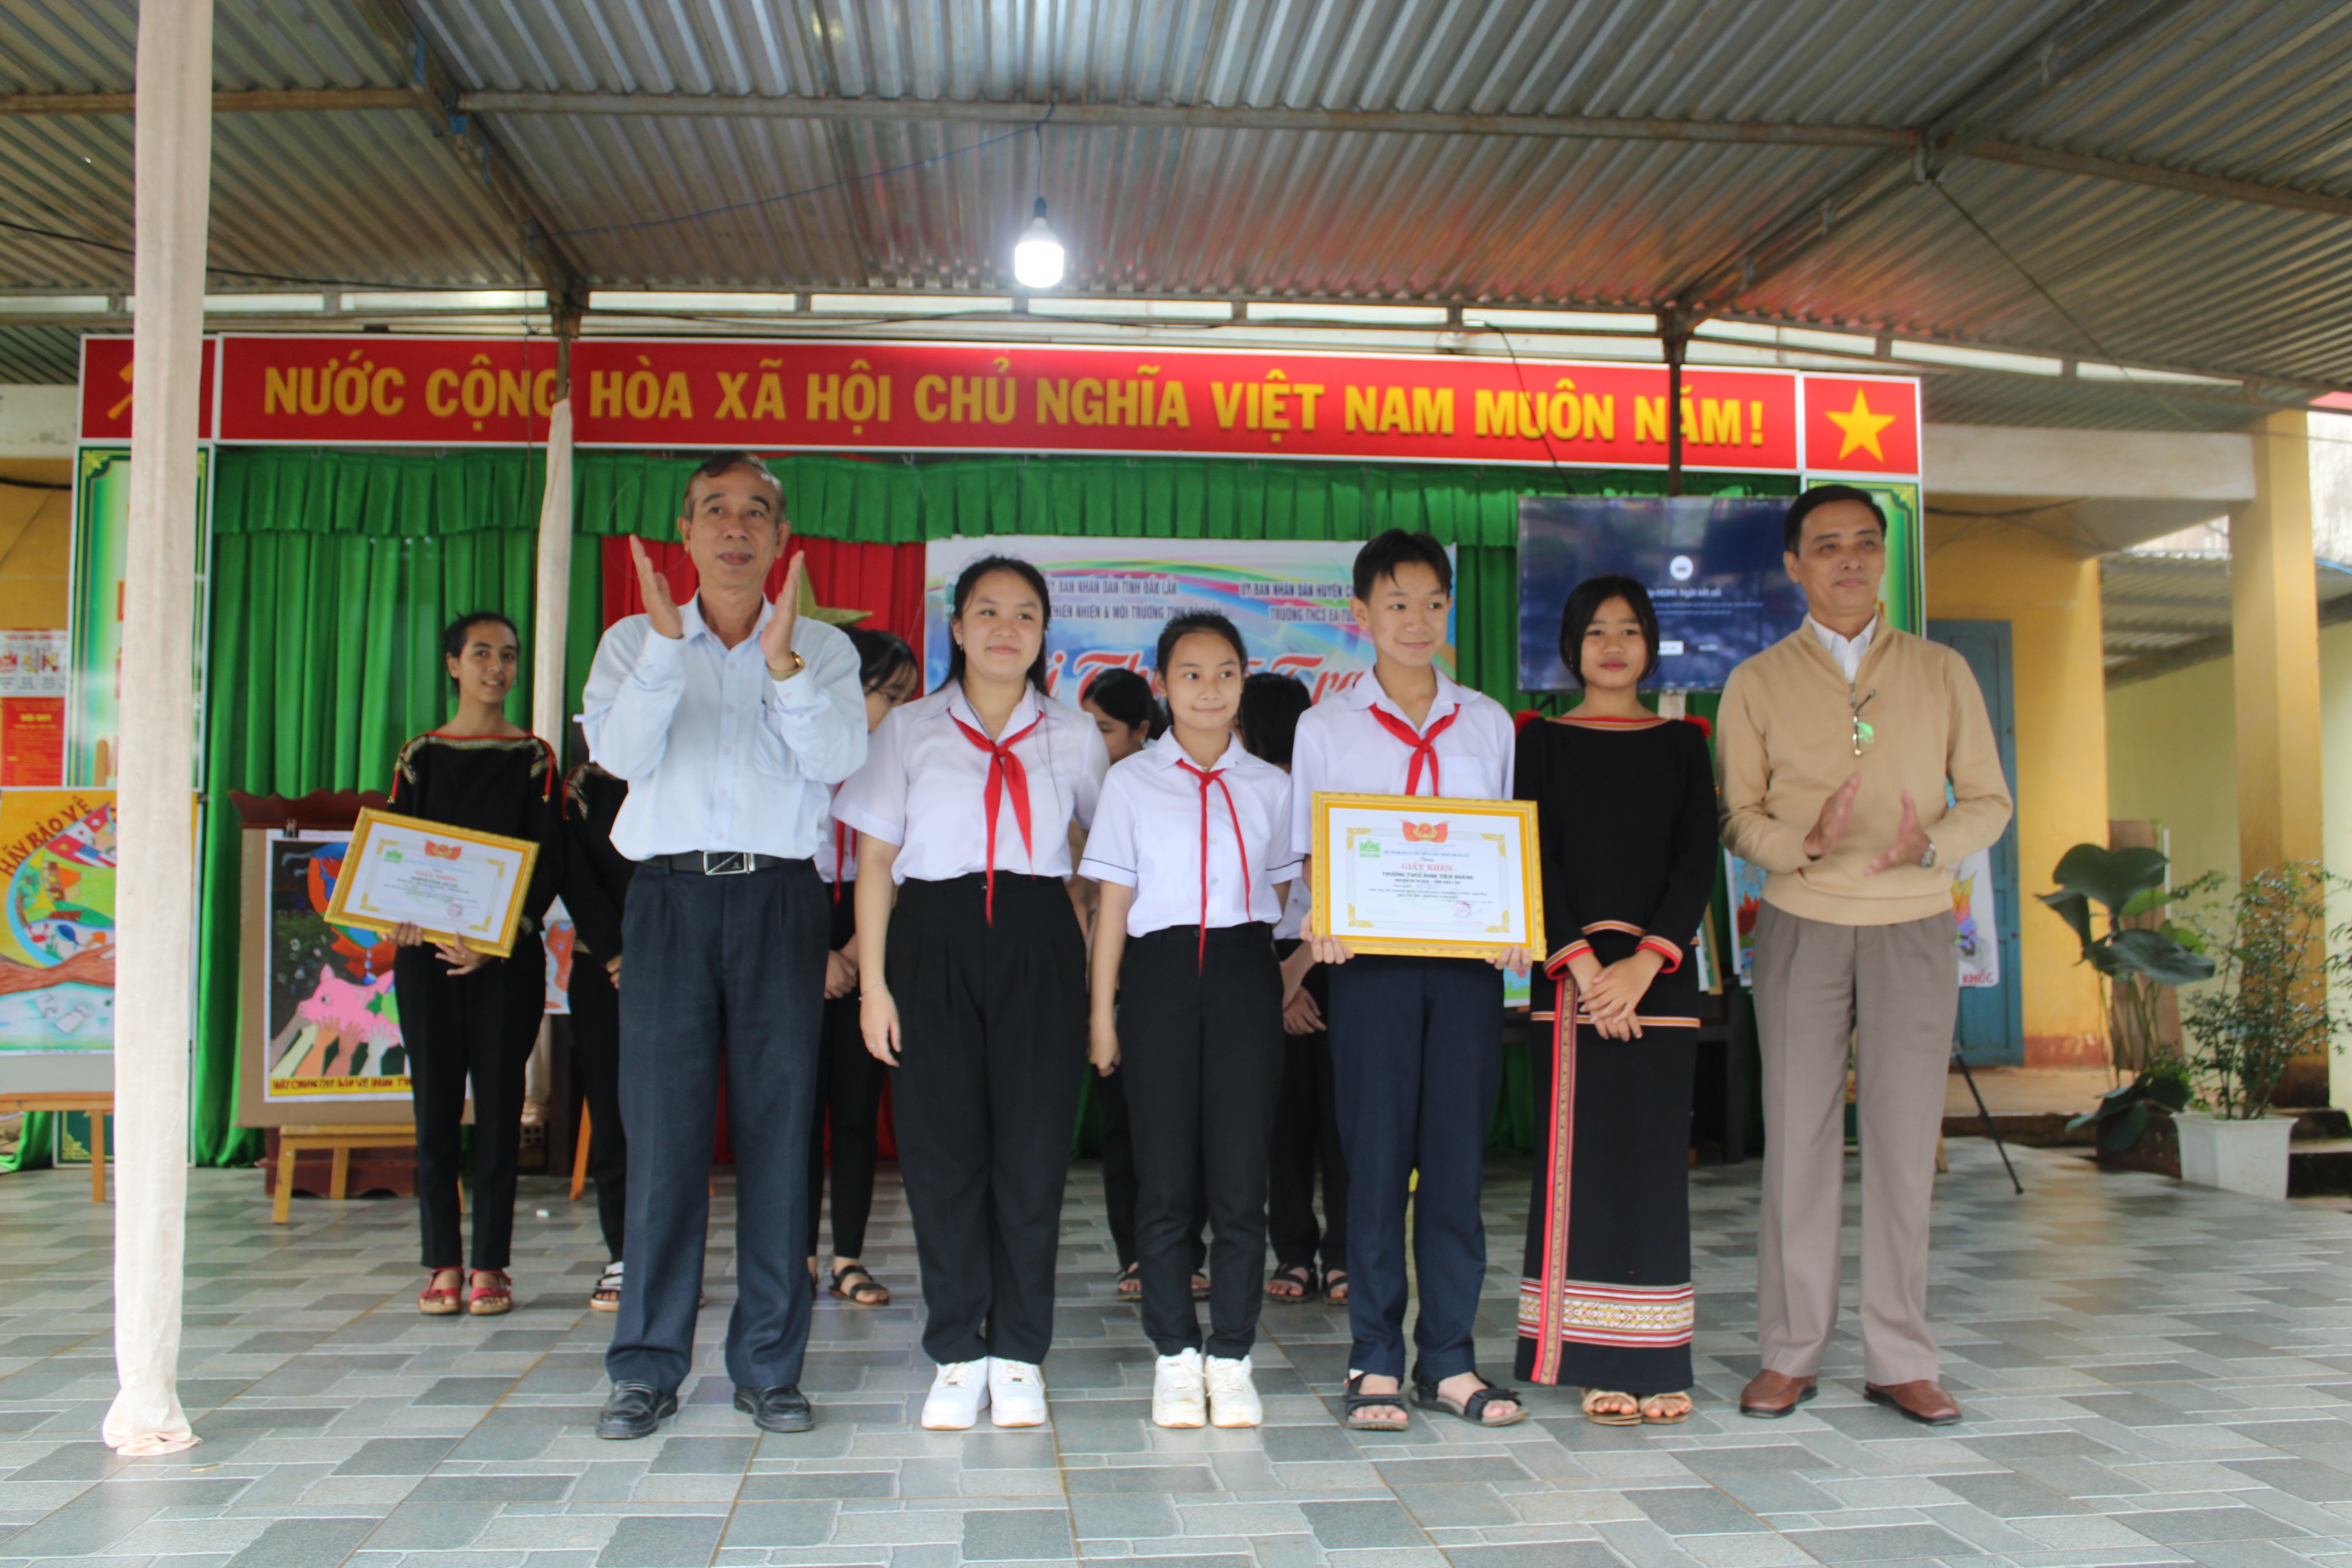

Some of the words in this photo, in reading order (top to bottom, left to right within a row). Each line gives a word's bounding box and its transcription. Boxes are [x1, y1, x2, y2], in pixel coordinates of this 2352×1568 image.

[263, 349, 405, 416] NƯỚC
[425, 353, 557, 431] CỘNG
[588, 355, 693, 419] HÒA
[713, 358, 786, 420] XÃ
[806, 359, 891, 435] HỘI
[913, 356, 1016, 424] CHỦ
[1035, 364, 1191, 428] NGHĨA
[1210, 368, 1325, 444] VIỆT
[1344, 385, 1455, 436] NAM
[1474, 377, 1615, 443] MUÔN
[1059, 580, 1074, 593] BAN
[1077, 576, 1099, 594] NHÂN
[1103, 576, 1119, 594] DÂN
[1254, 584, 1269, 597] BAN
[1273, 580, 1294, 597] NHÂN
[1297, 580, 1313, 597] DÂN
[1075, 601, 1100, 619] NHIÊN
[1270, 603, 1303, 621] TRƯỜNG
[1305, 608, 1326, 621] THCS
